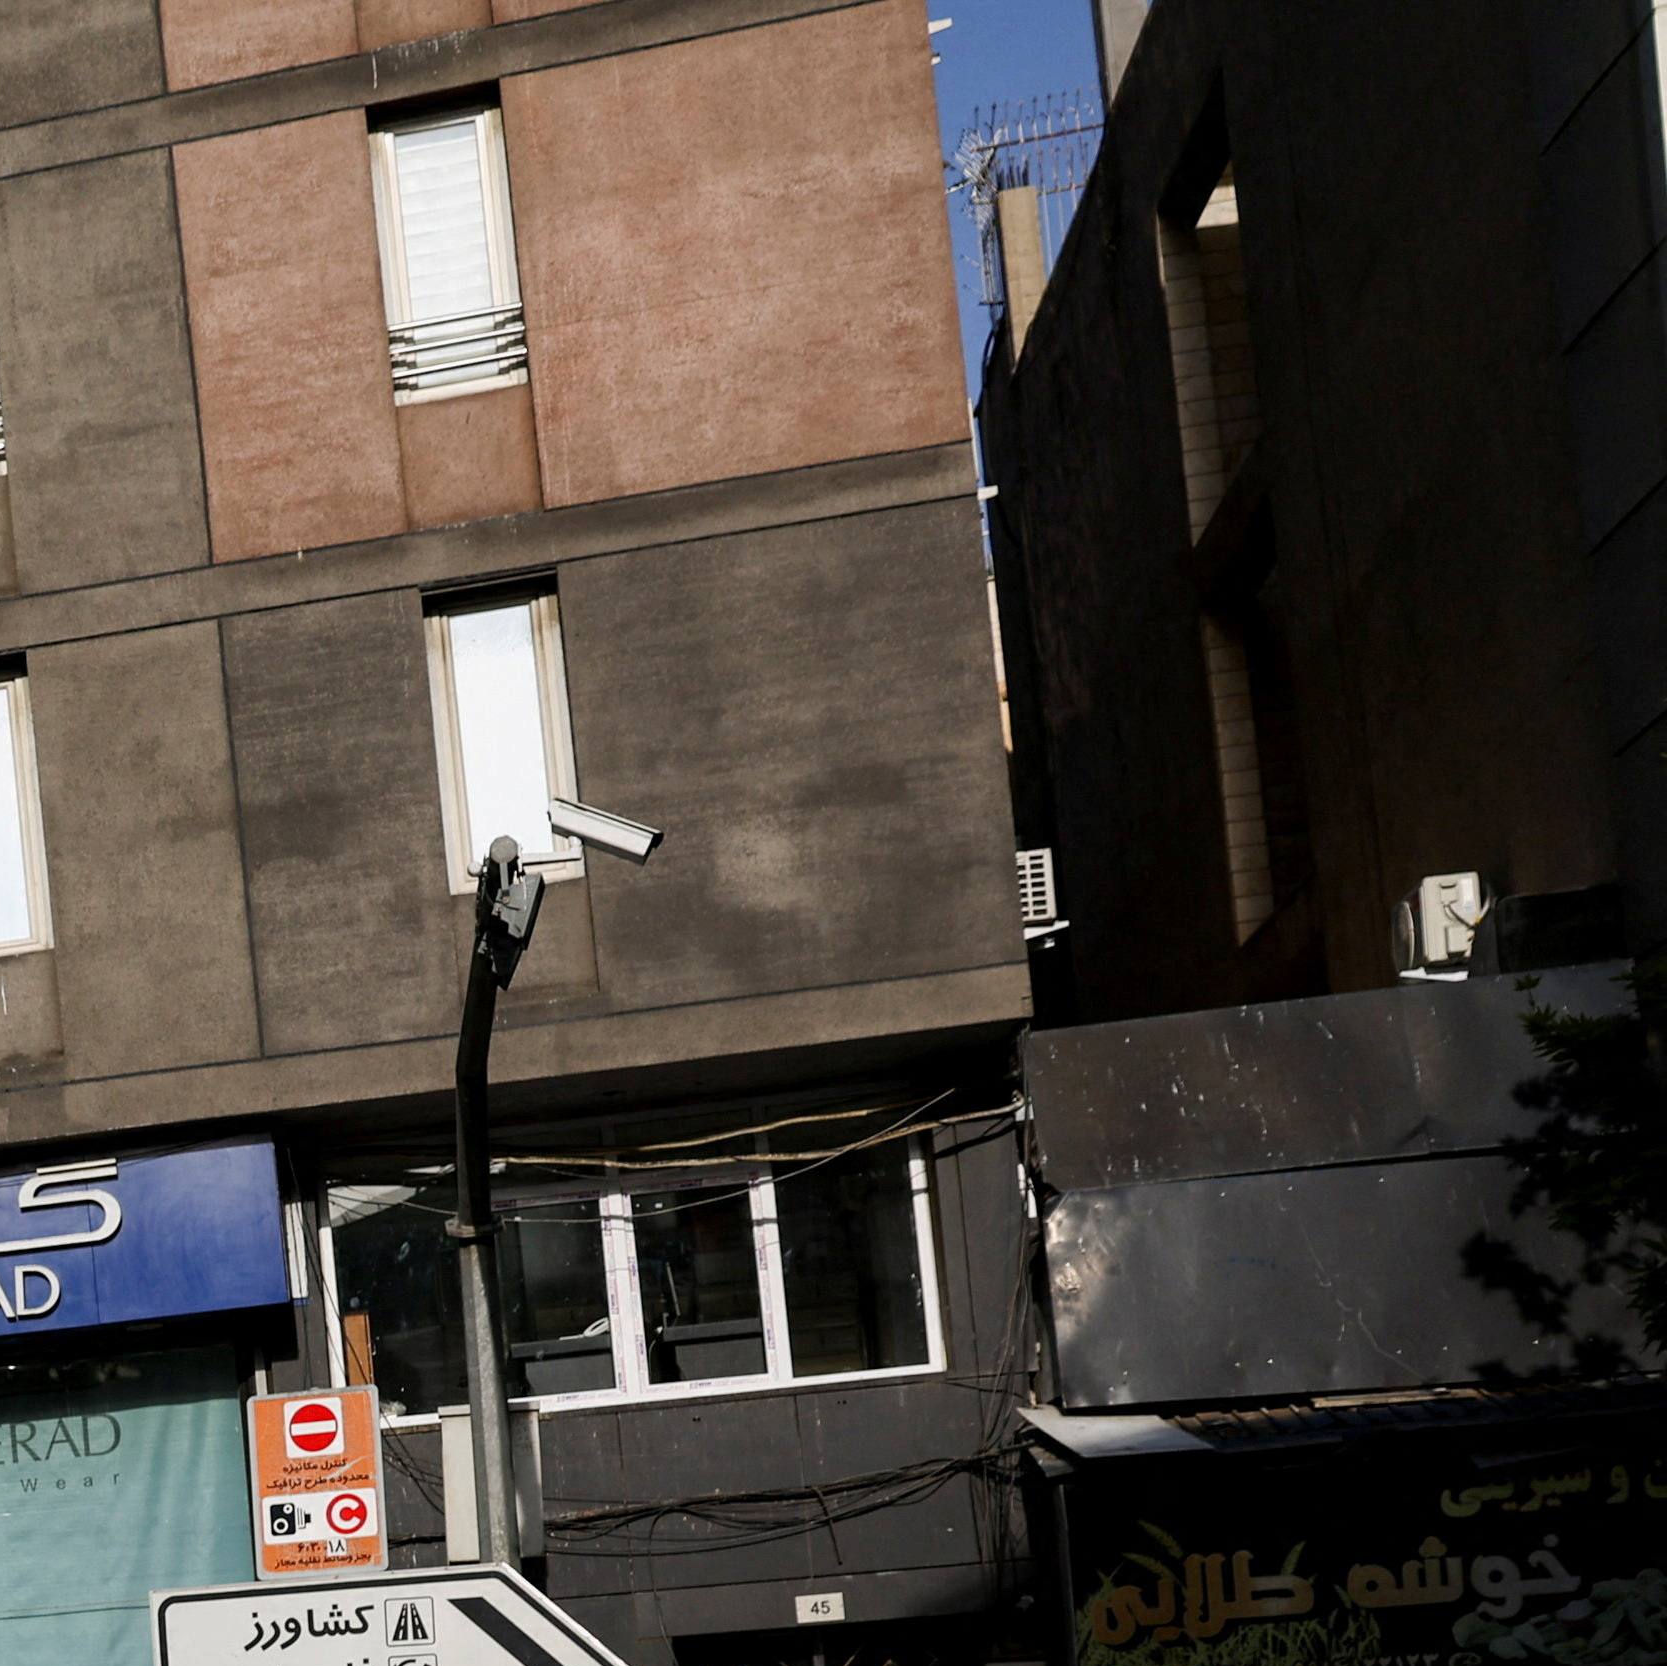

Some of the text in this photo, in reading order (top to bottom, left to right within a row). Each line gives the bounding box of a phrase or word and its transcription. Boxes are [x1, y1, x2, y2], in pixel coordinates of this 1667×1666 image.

[1346, 1533, 1582, 1620] خوشه
[244, 1603, 375, 1652] کشاورز
[810, 1601, 831, 1615] 45
